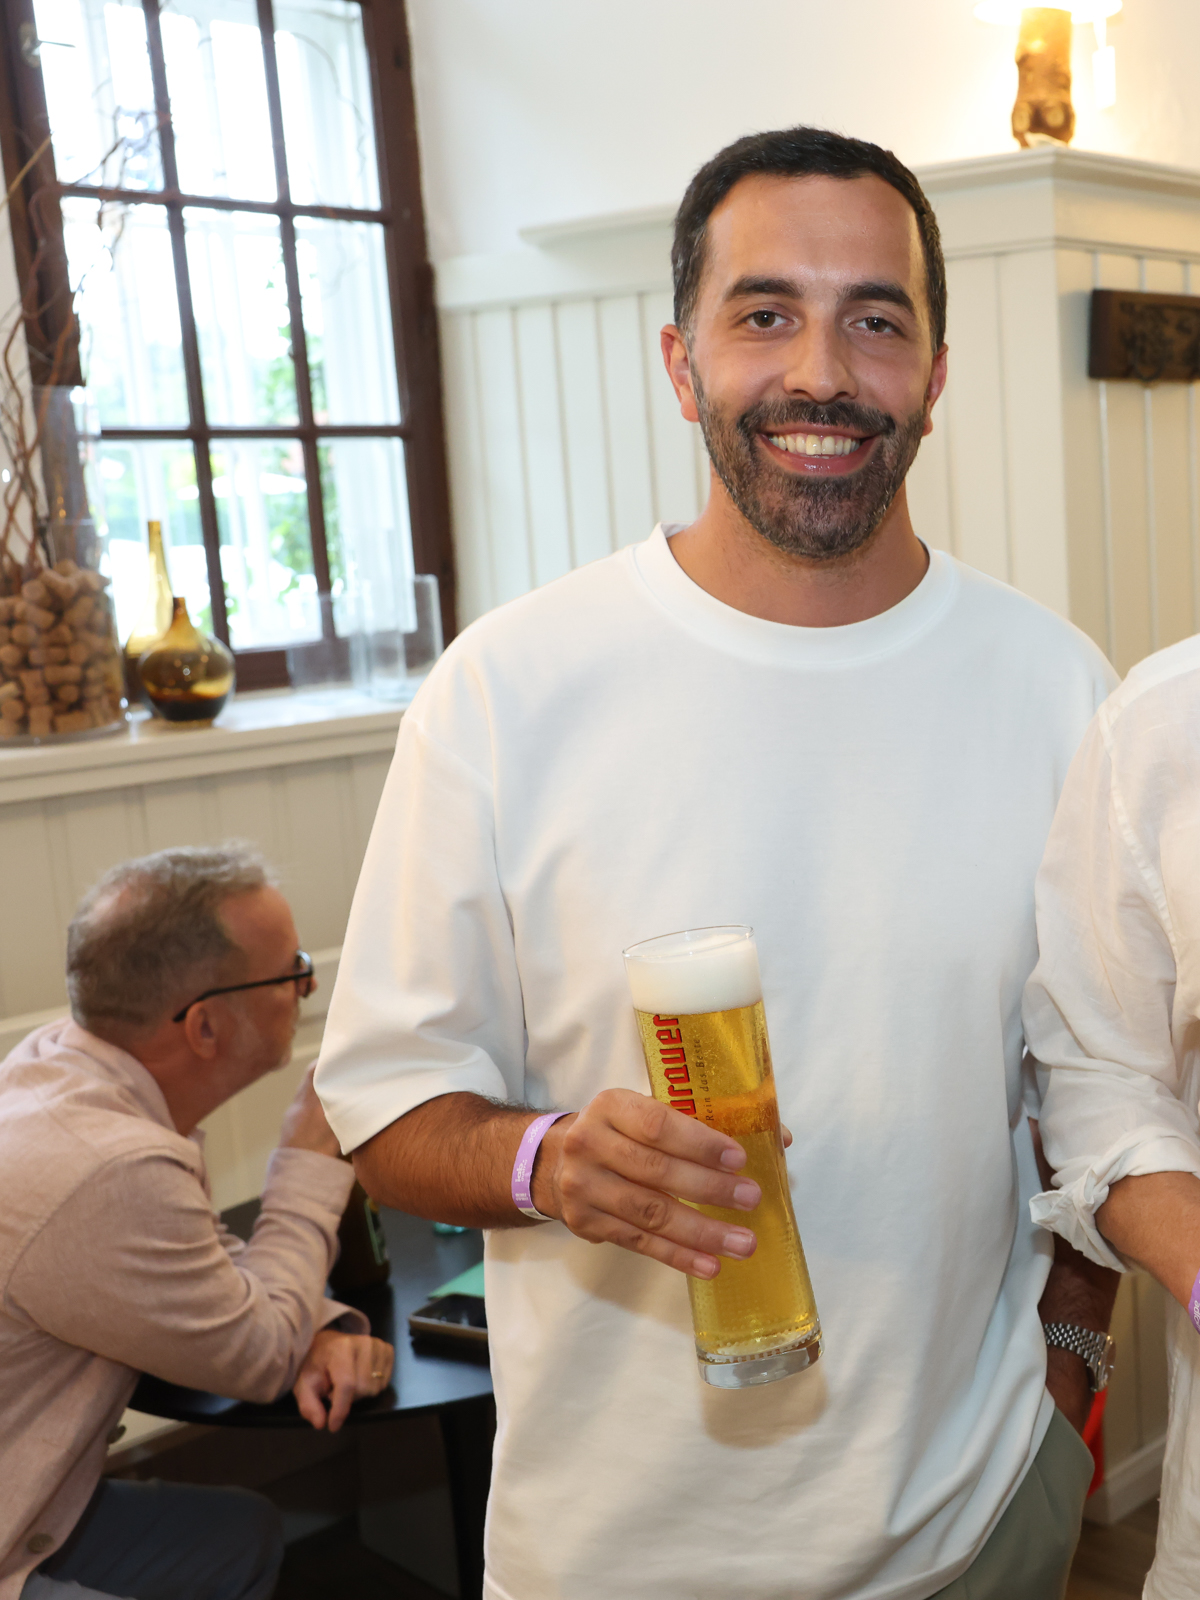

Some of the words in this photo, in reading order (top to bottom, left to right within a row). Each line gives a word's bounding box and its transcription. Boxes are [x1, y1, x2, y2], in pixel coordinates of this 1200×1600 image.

[653, 1015, 697, 1118] urauer
[694, 1039, 705, 1068] Beste
[700, 1073, 710, 1092] das
[705, 1097, 715, 1121] Rein
